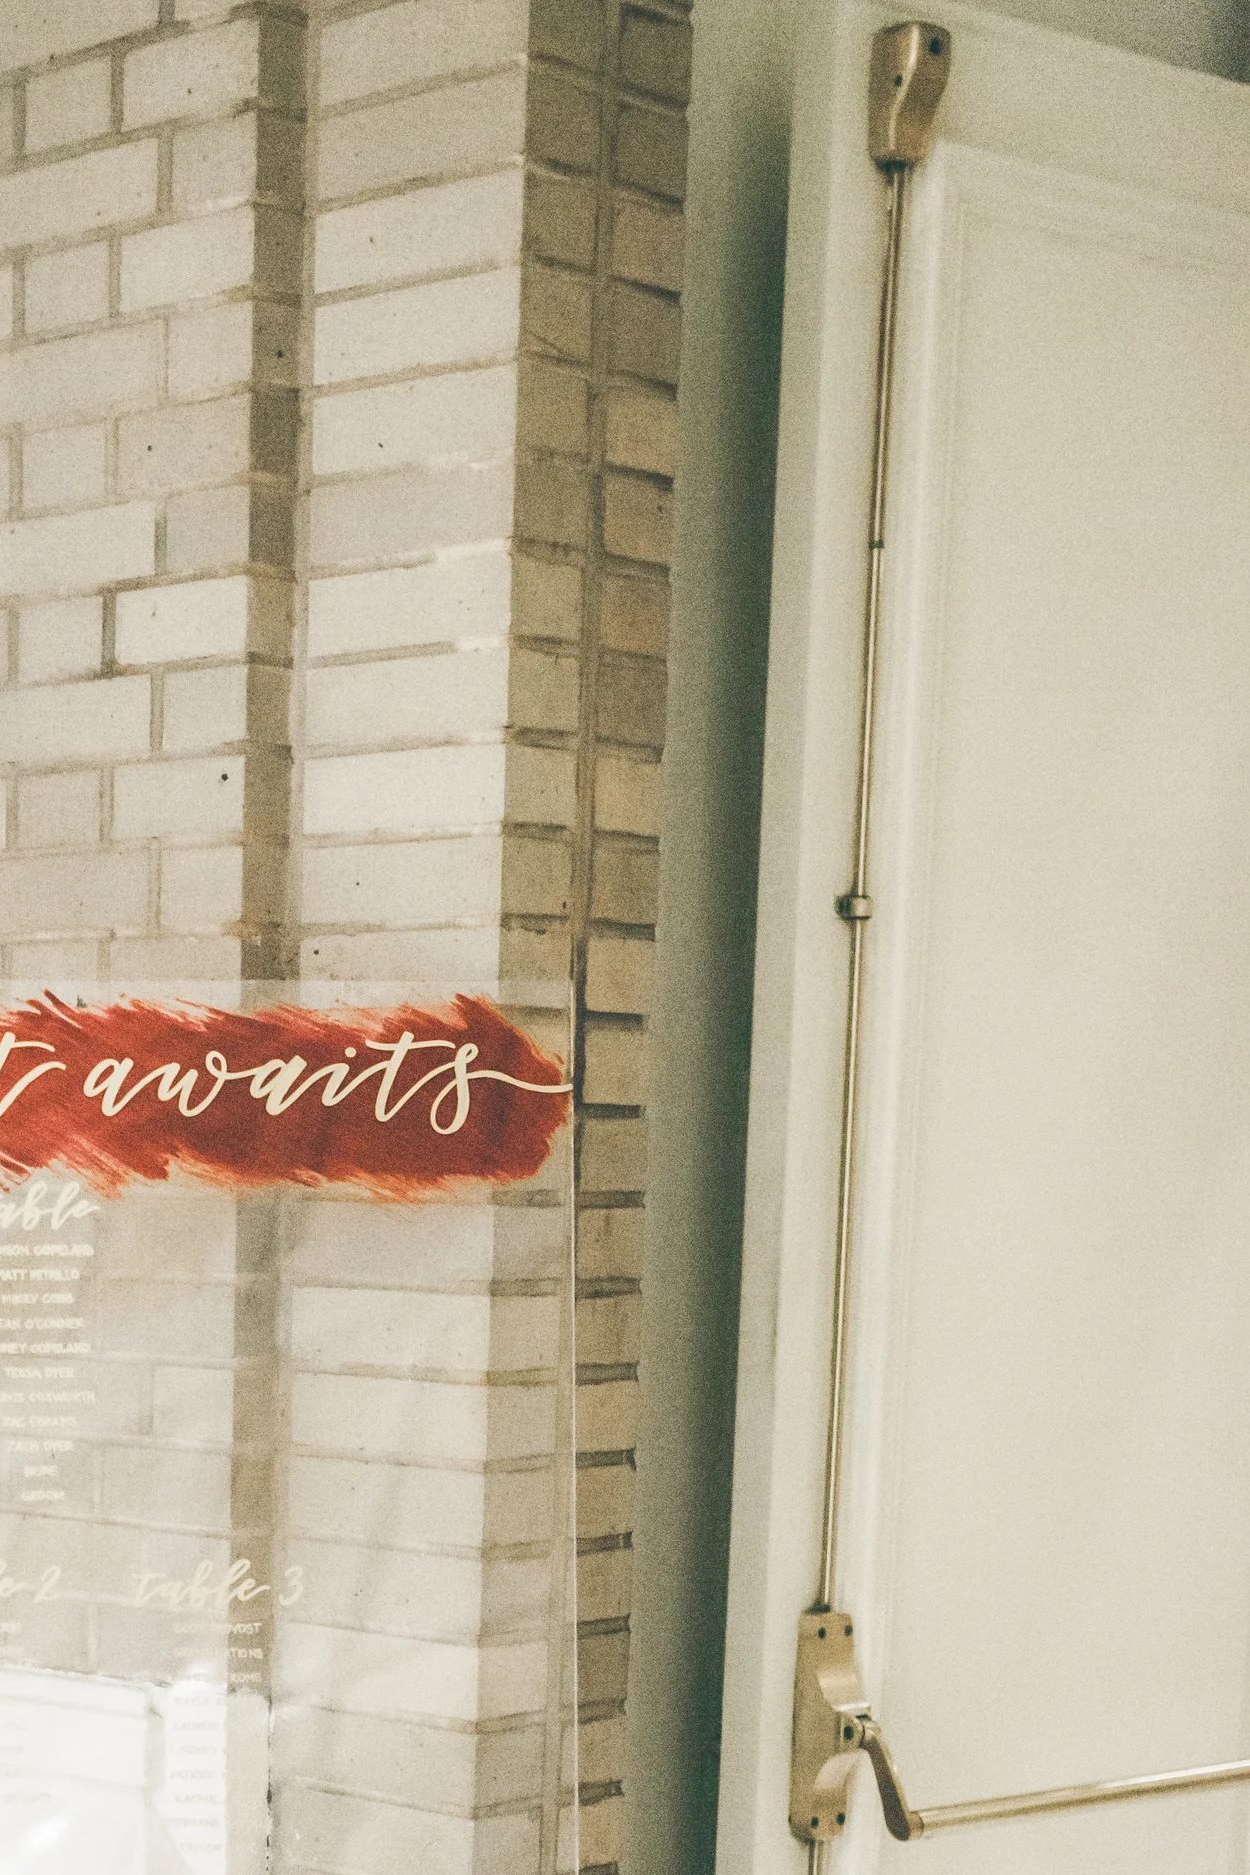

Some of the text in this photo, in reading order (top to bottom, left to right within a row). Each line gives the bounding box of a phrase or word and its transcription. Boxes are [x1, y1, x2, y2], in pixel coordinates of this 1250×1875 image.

[84, 1031, 572, 1134] awaits
[33, 1565, 62, 1604] 2
[131, 1557, 303, 1609] table 3
